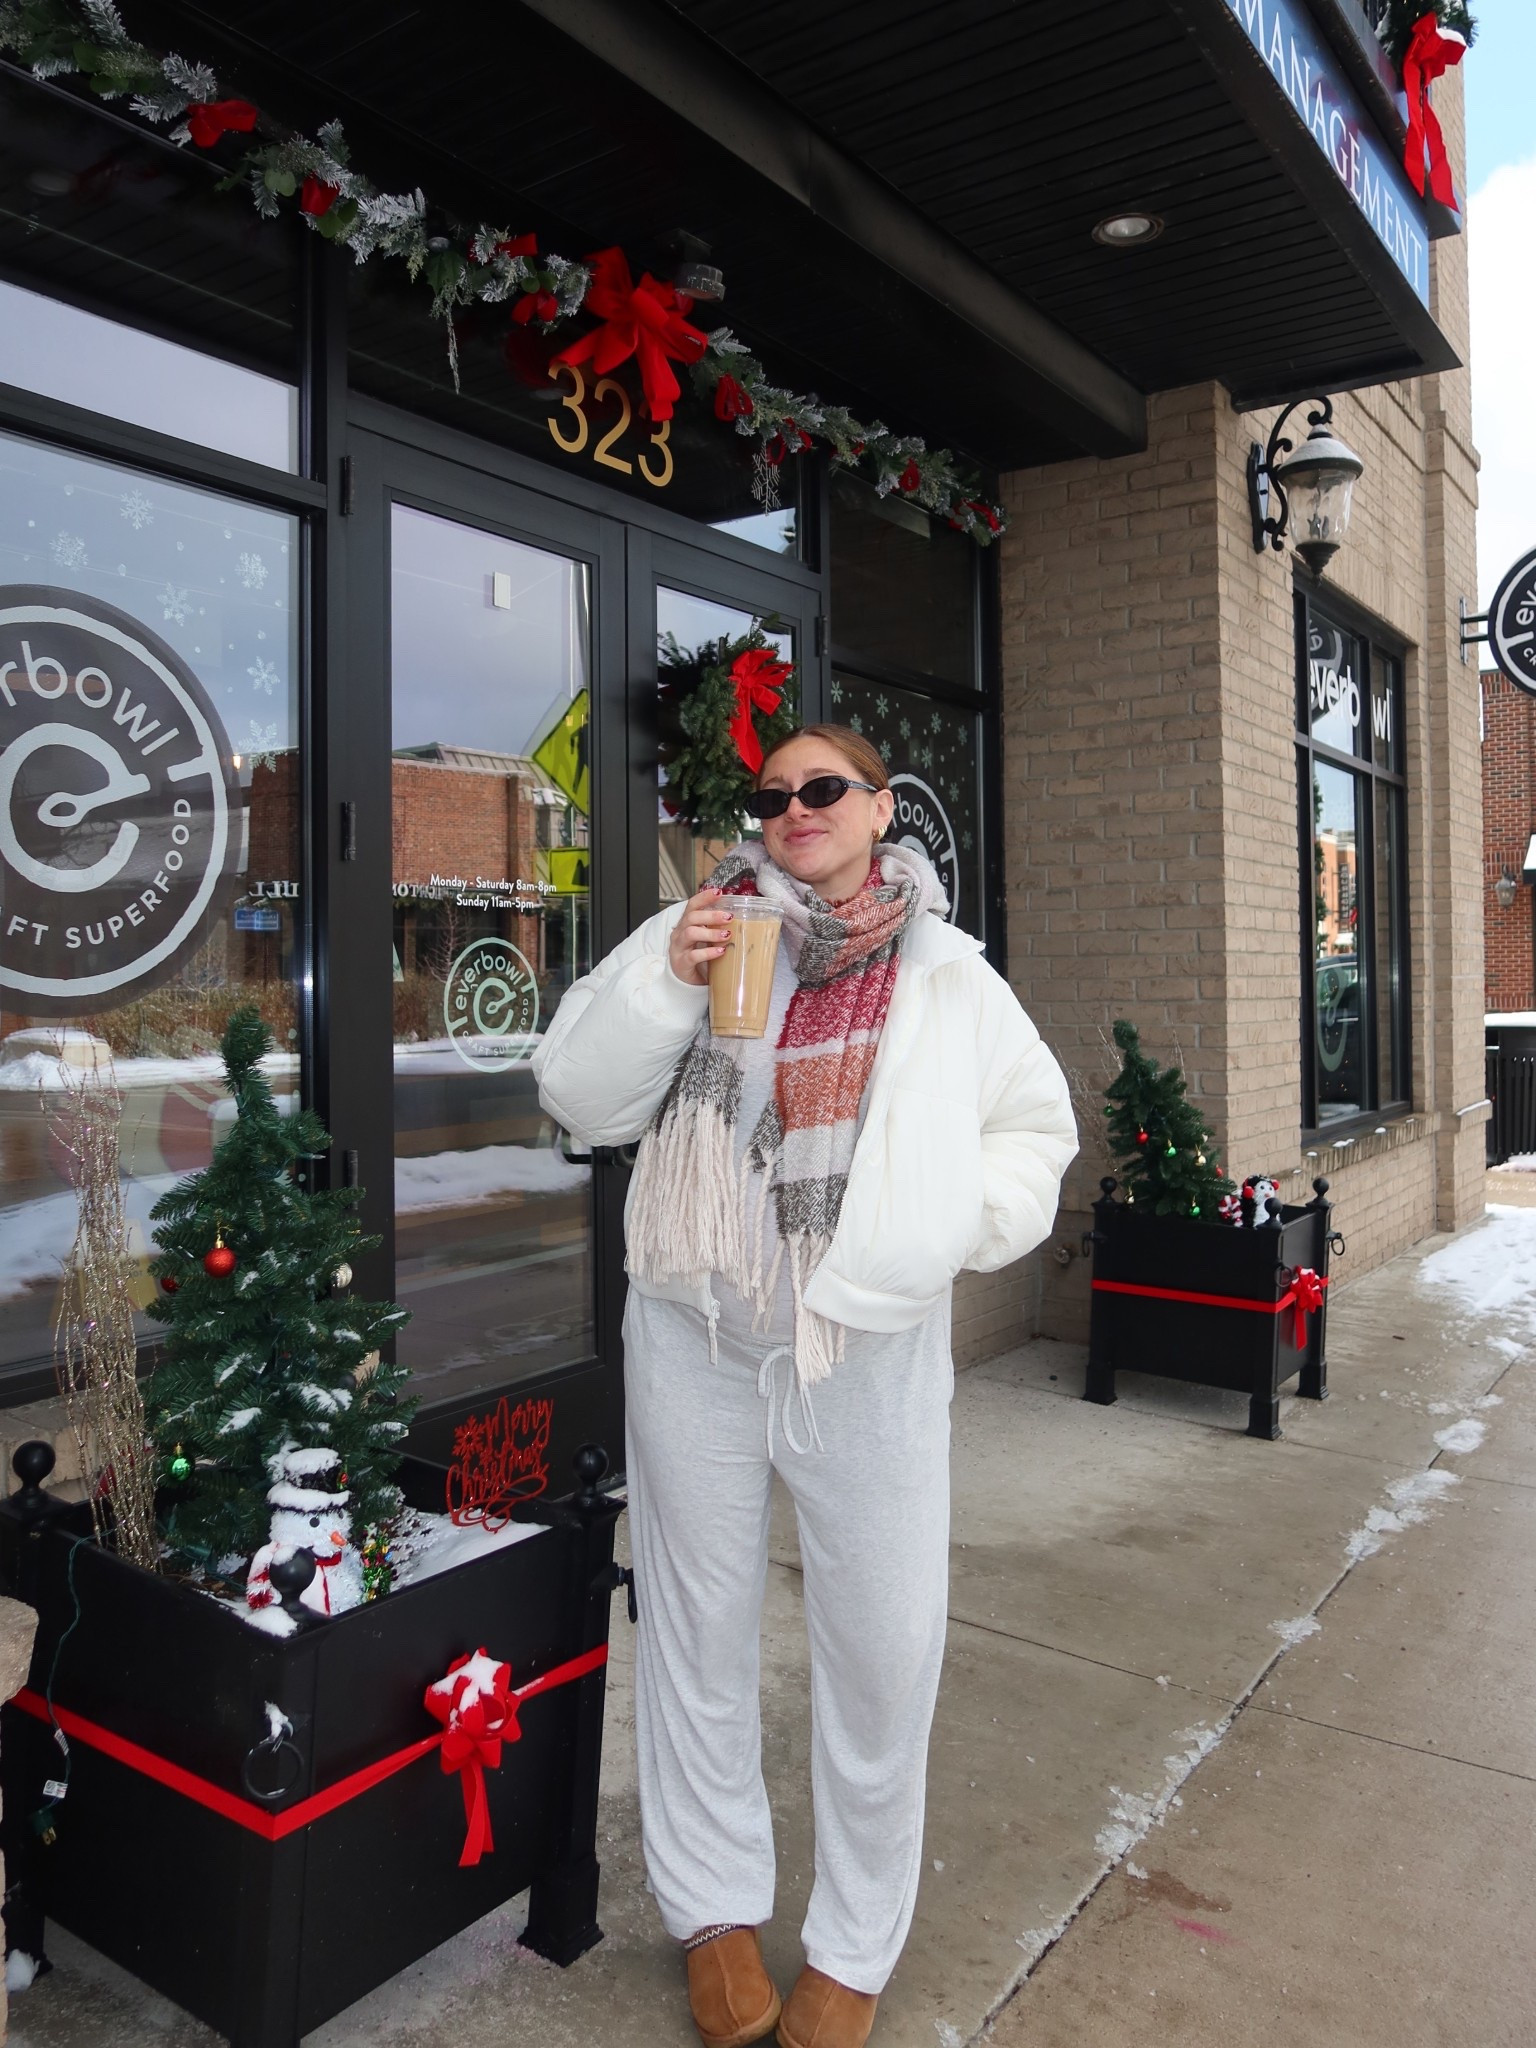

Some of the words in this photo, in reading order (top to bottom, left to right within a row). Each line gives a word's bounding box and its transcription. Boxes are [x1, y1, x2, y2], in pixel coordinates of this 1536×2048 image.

[1234, 0, 1422, 291] MANAGEMENT
[547, 362, 674, 487] 323
[64, 798, 192, 950] SUPERFOOD
[430, 873, 468, 892] Monday
[476, 876, 515, 895] Saturday
[516, 879, 557, 896] 8am-8pm
[456, 894, 489, 912] Sunday
[491, 896, 535, 913] 11am-5pm
[455, 950, 526, 1011] everbowl
[462, 1030, 490, 1056] CRAFT
[493, 998, 529, 1056] SUPERFOOD
[479, 1396, 554, 1452] Merry
